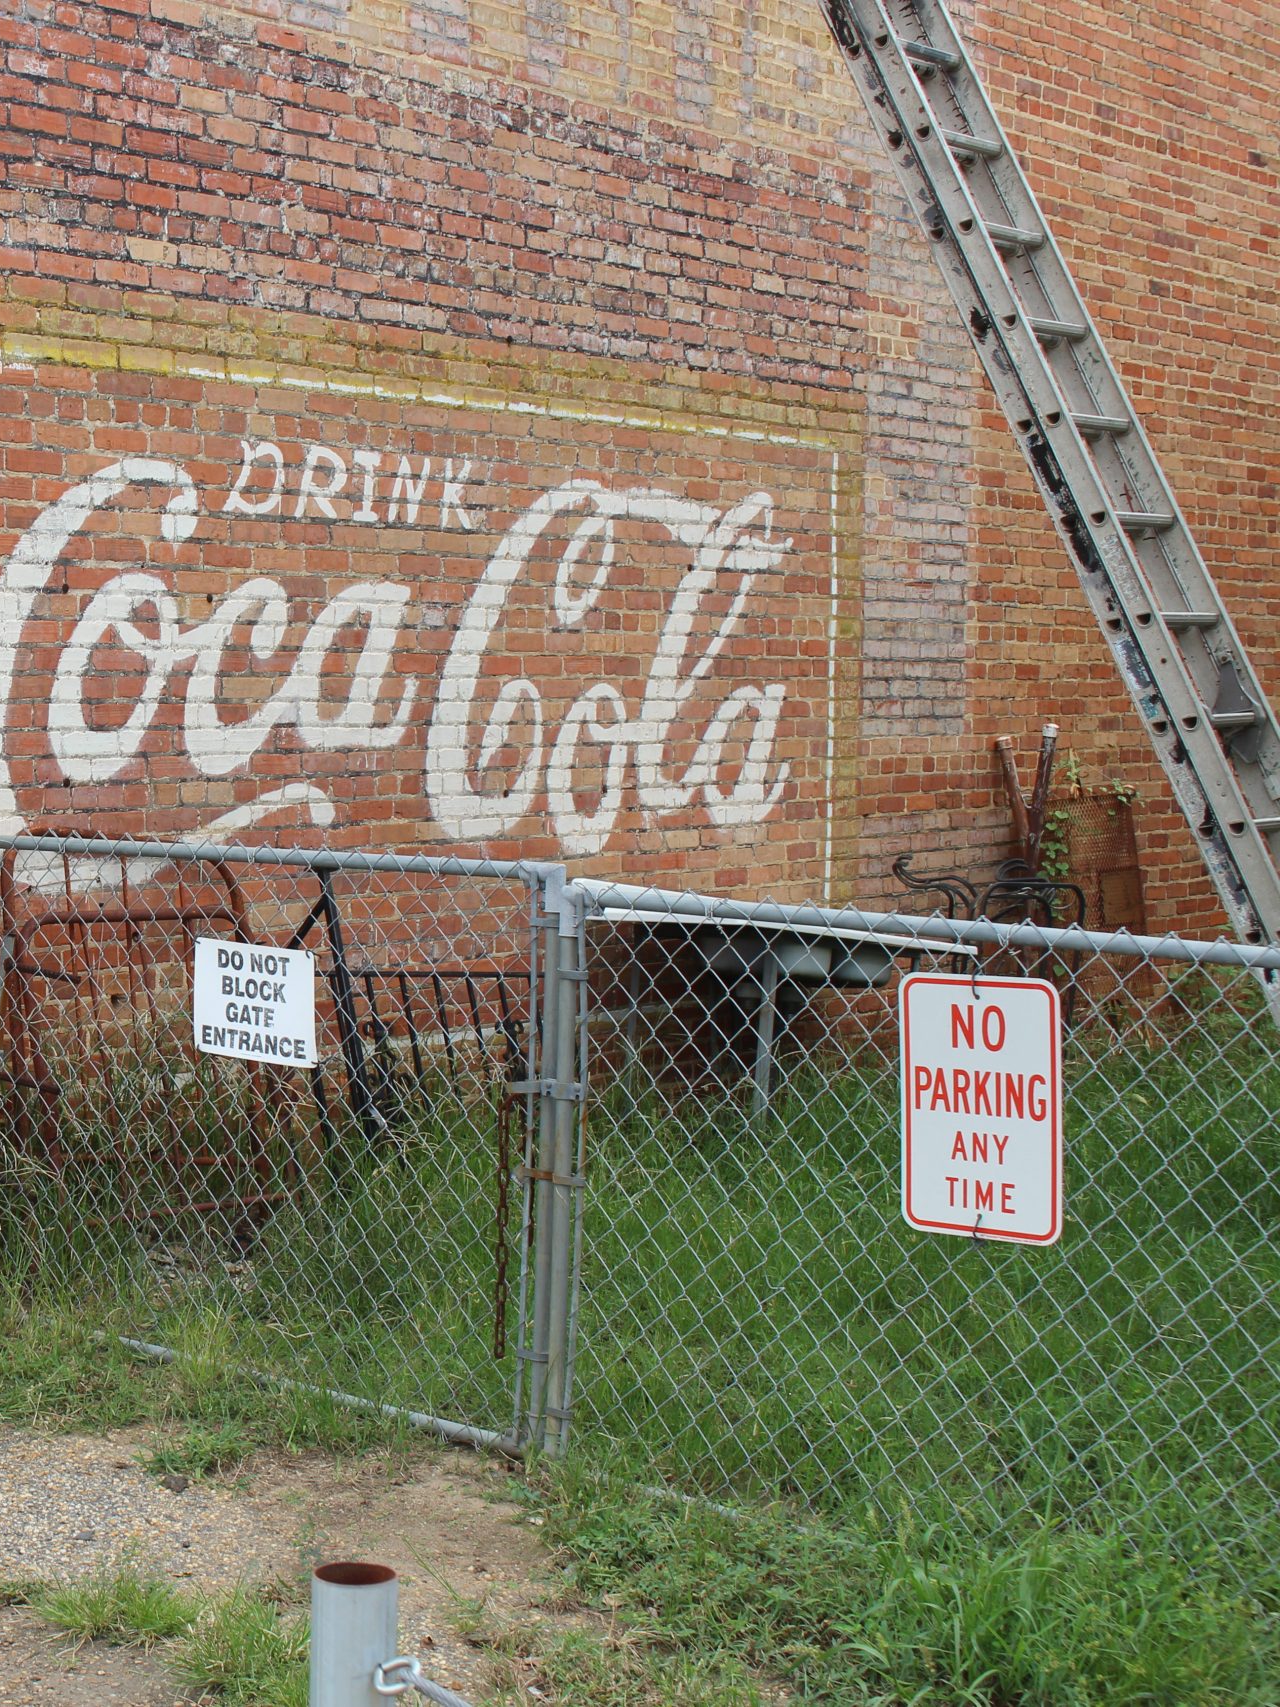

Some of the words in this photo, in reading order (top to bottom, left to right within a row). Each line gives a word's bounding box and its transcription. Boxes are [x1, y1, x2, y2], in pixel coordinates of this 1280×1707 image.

[222, 440, 472, 530] DRINK
[424, 478, 794, 857] Cola
[217, 948, 244, 971] DO
[250, 952, 290, 977] NOT
[221, 974, 287, 1003] BLOCK
[225, 1002, 275, 1028] GATE
[951, 1003, 1006, 1052] NO
[201, 1024, 307, 1060] ENTRANCE
[914, 1065, 1047, 1122] PARKING
[951, 1130, 1009, 1165] ANY
[945, 1176, 1016, 1215] TIME
